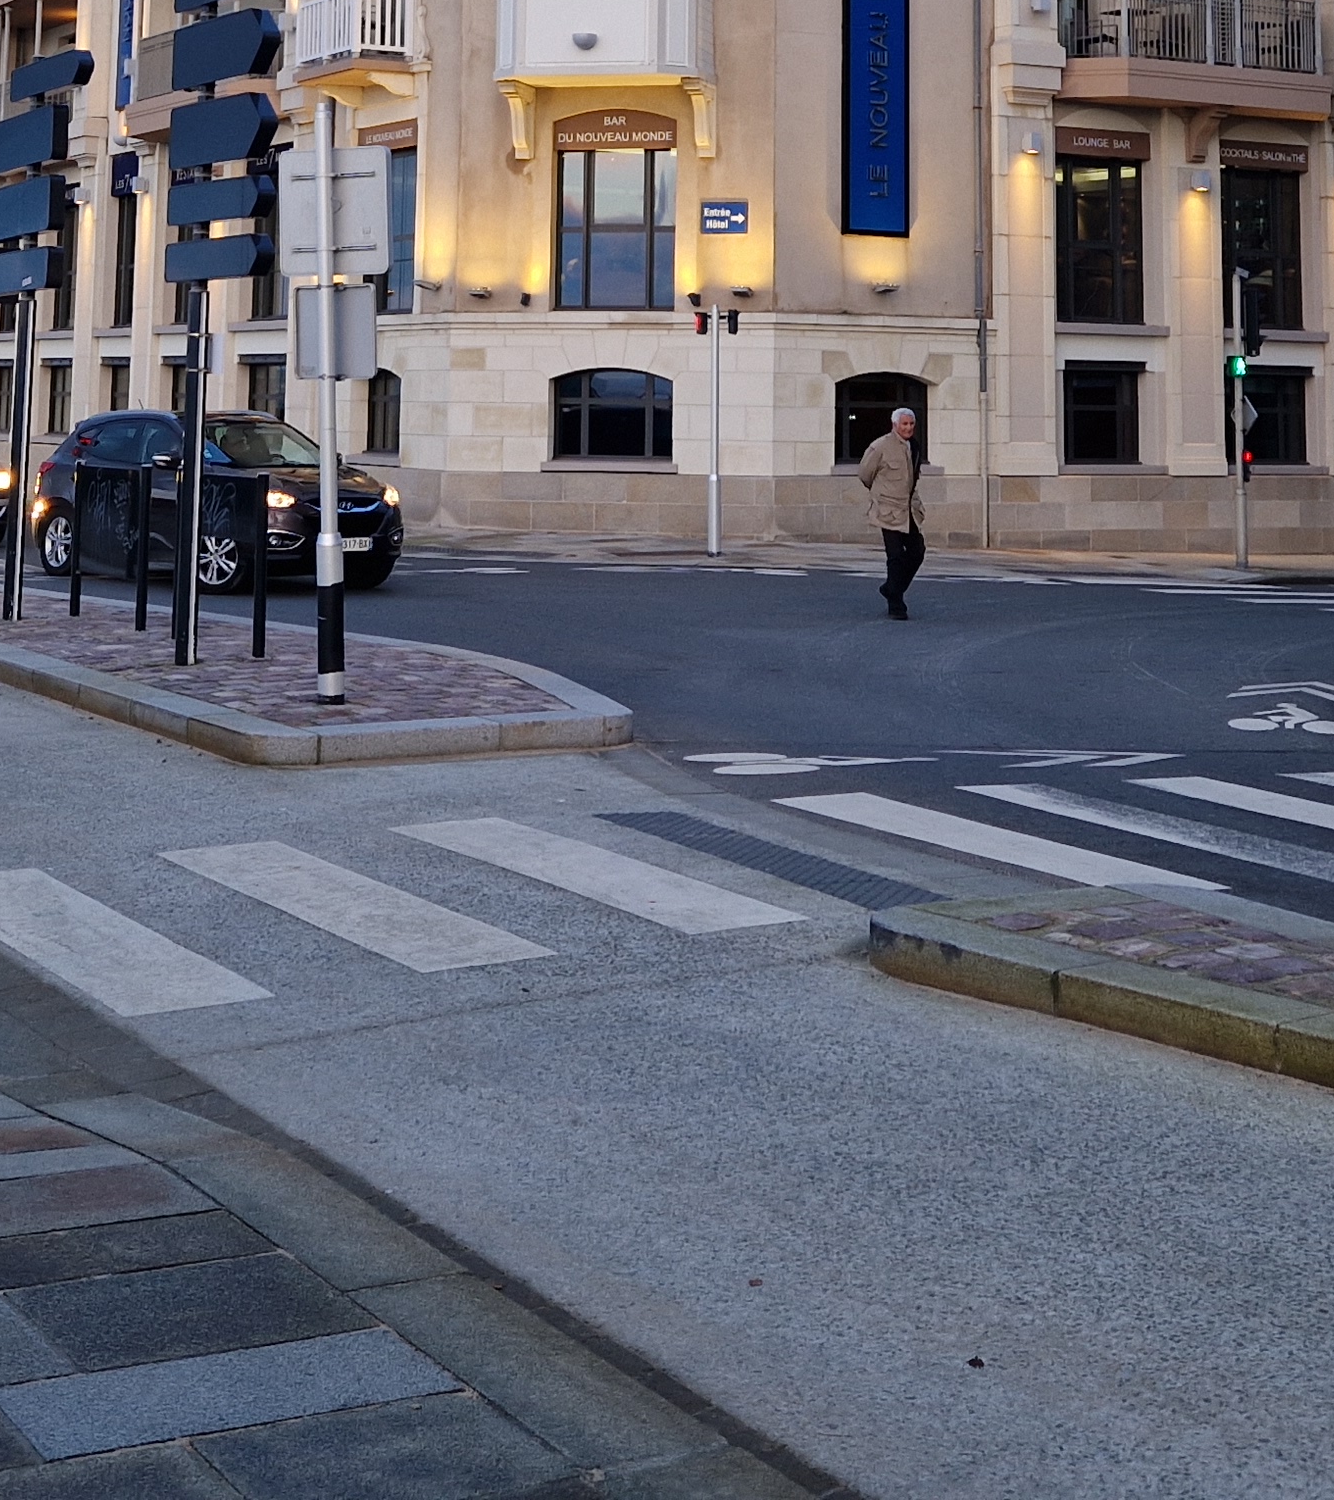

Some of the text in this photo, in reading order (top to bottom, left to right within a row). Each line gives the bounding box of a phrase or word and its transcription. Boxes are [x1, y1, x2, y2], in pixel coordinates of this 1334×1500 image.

[870, 11, 888, 148] NOUVEAU
[603, 116, 626, 126] BAR
[558, 130, 673, 143] DU NOUVEAU MONDE
[1073, 136, 1131, 150] LOUNGE BAR
[870, 165, 888, 197] LE
[704, 207, 731, 217] Entrée
[706, 219, 729, 229] Hôtel
